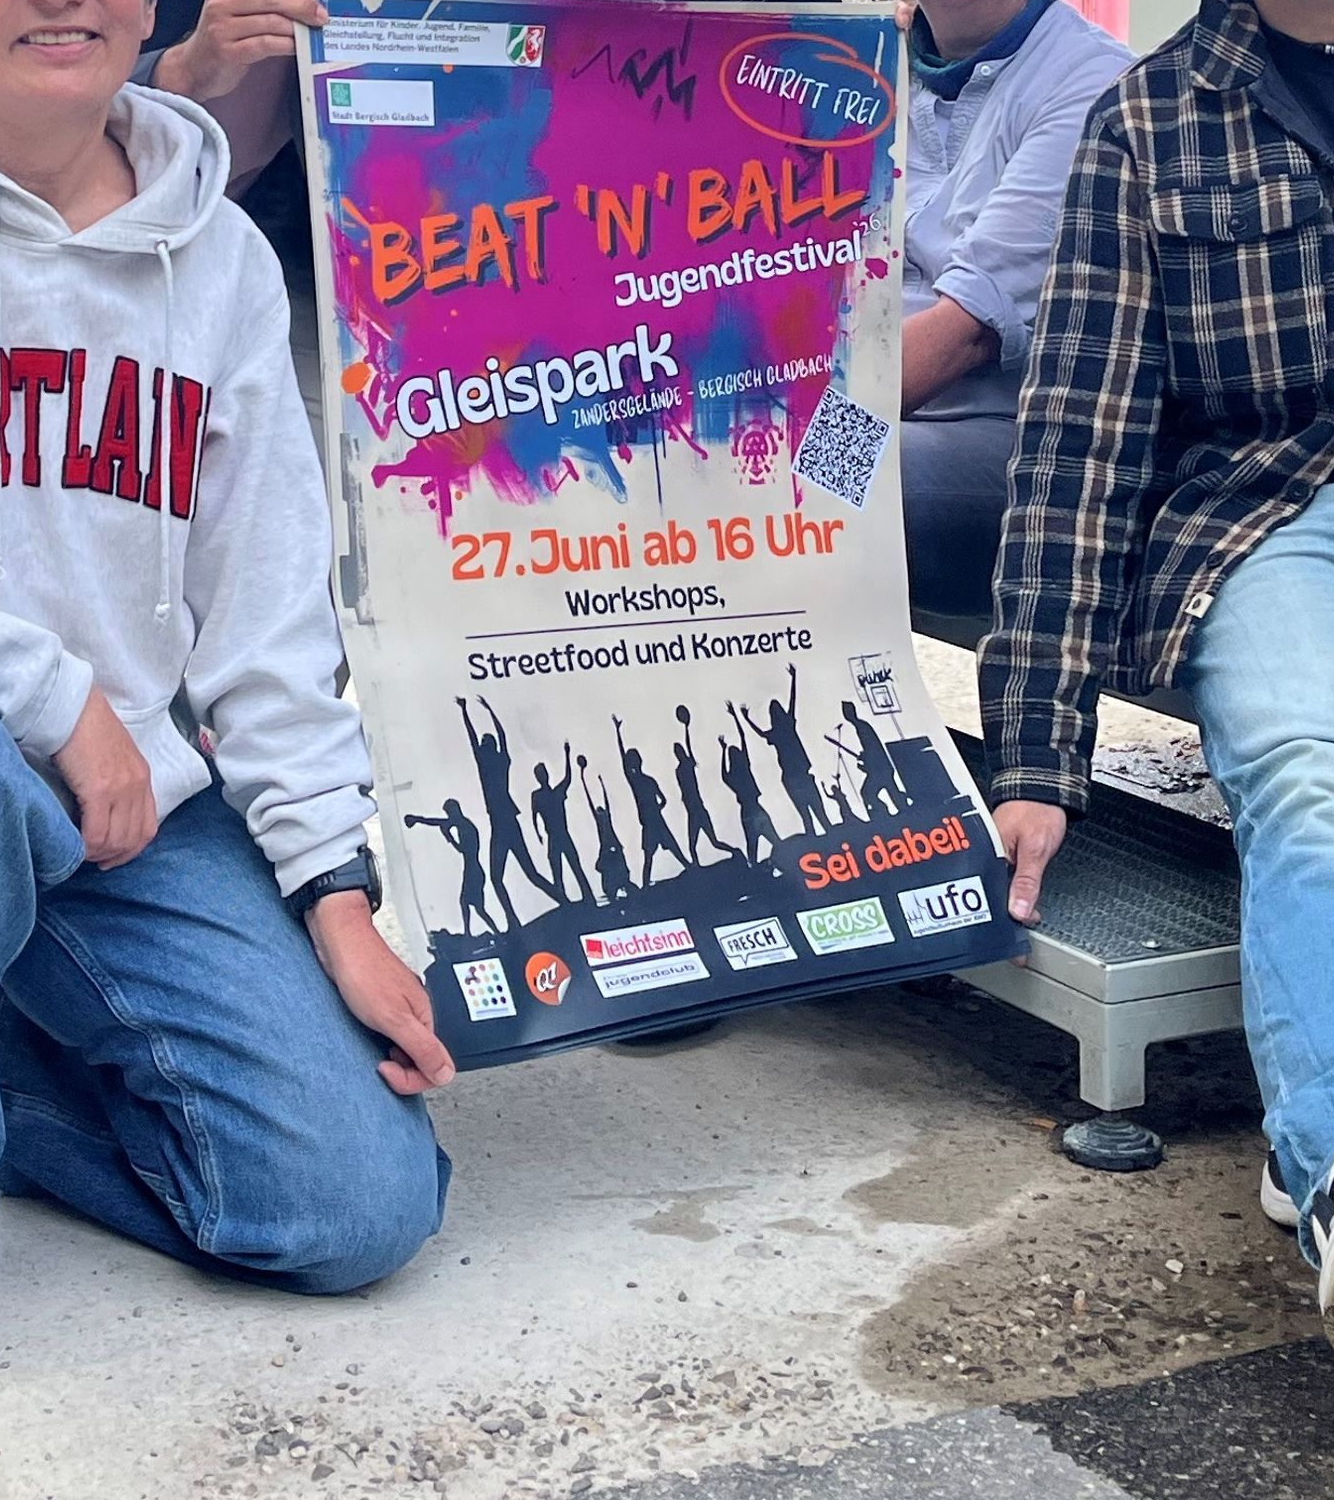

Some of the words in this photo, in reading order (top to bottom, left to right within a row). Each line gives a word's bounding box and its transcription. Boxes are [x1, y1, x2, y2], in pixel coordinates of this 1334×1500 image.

[736, 54, 829, 109] EINTRITT
[833, 88, 881, 125] FREI
[367, 193, 559, 305] BEAT
[687, 149, 871, 244] BALL
[614, 229, 863, 309] Jugendfestival
[395, 322, 680, 440] Gleispark
[571, 382, 682, 429] ZANDERSGELÄNDE
[698, 368, 763, 399] BERGISCH
[766, 354, 833, 386] GLADBACH
[643, 522, 697, 565] ab
[708, 517, 754, 562] 16
[767, 512, 845, 558] Uhr
[565, 583, 727, 618] Workshops,
[468, 643, 629, 681] Streetfood
[635, 634, 686, 666] und
[693, 626, 813, 661] Konzerte
[798, 845, 861, 891] Sei
[865, 817, 970, 874] dabei!
[810, 904, 878, 938] CROSS
[925, 884, 982, 920] ufo
[604, 930, 692, 958] leichtsinn
[727, 927, 777, 953] FRESCH
